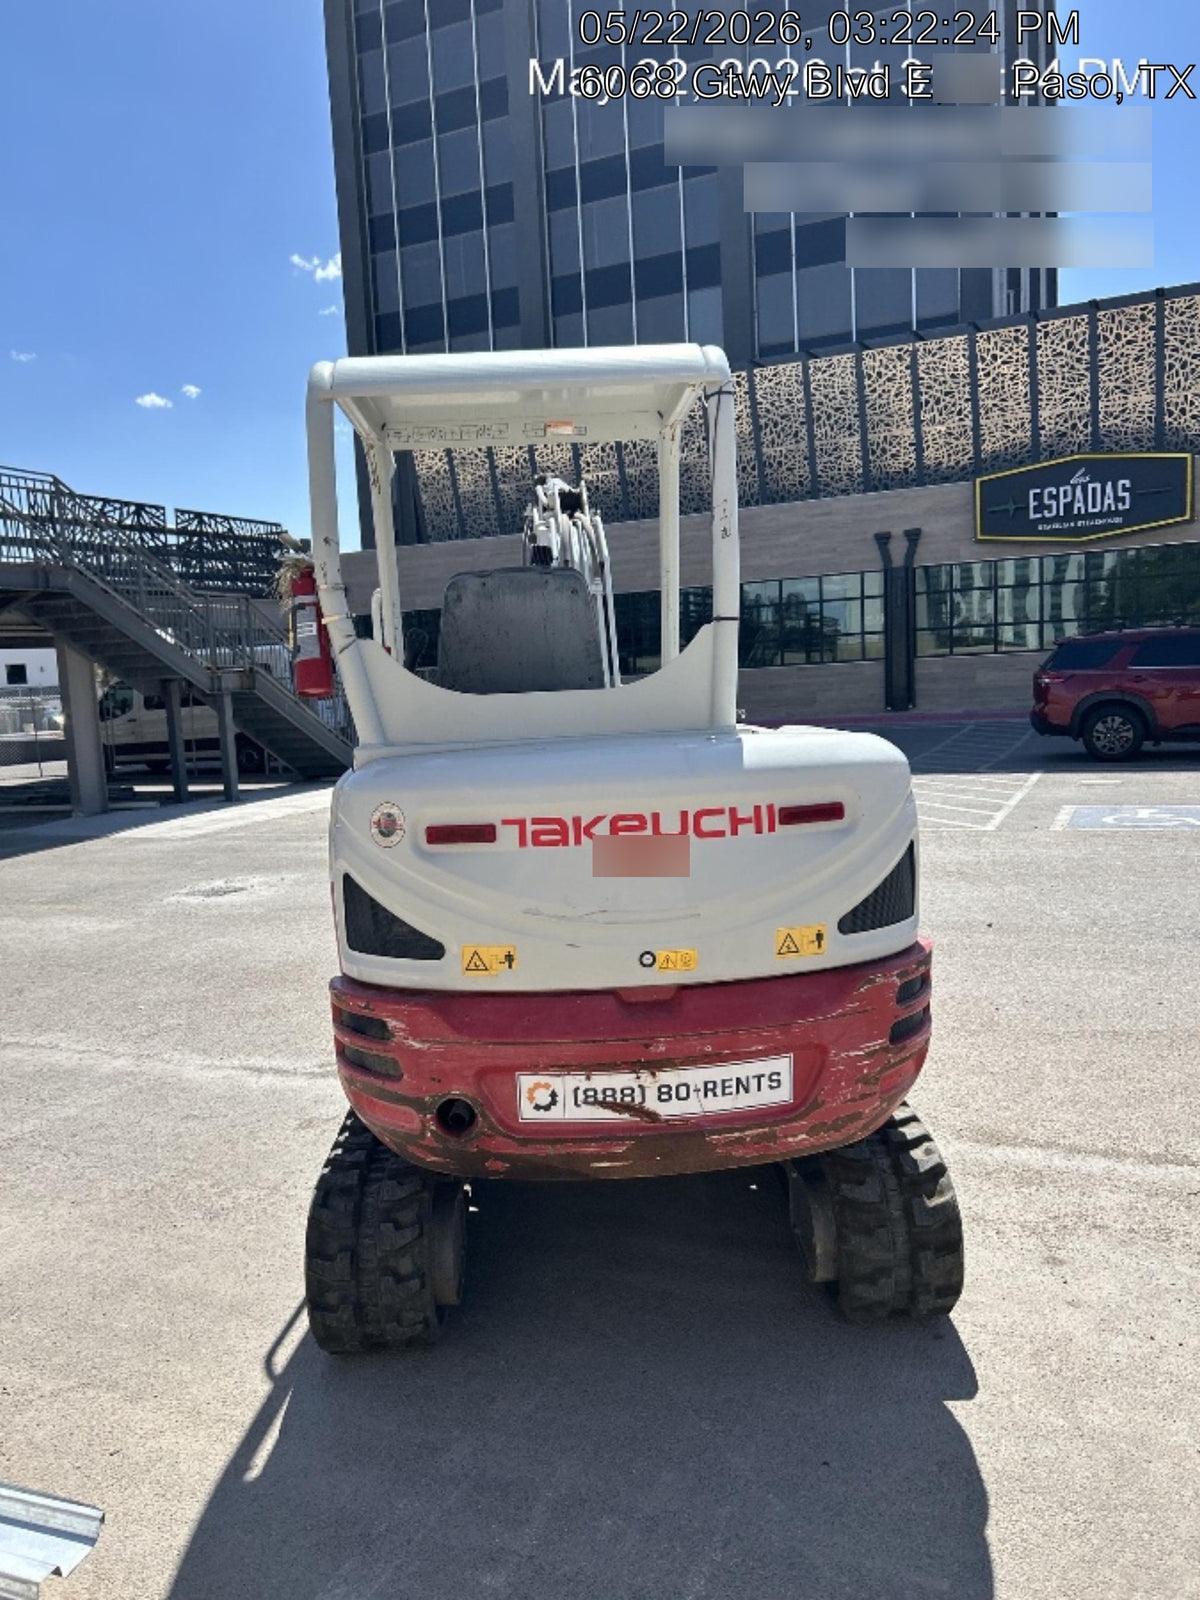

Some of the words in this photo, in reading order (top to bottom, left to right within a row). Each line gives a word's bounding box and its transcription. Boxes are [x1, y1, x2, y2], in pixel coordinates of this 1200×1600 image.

[1029, 479, 1132, 520] ESPADAS
[573, 1086, 646, 1108] (888)
[657, 1071, 782, 1103] 80-RENTS
